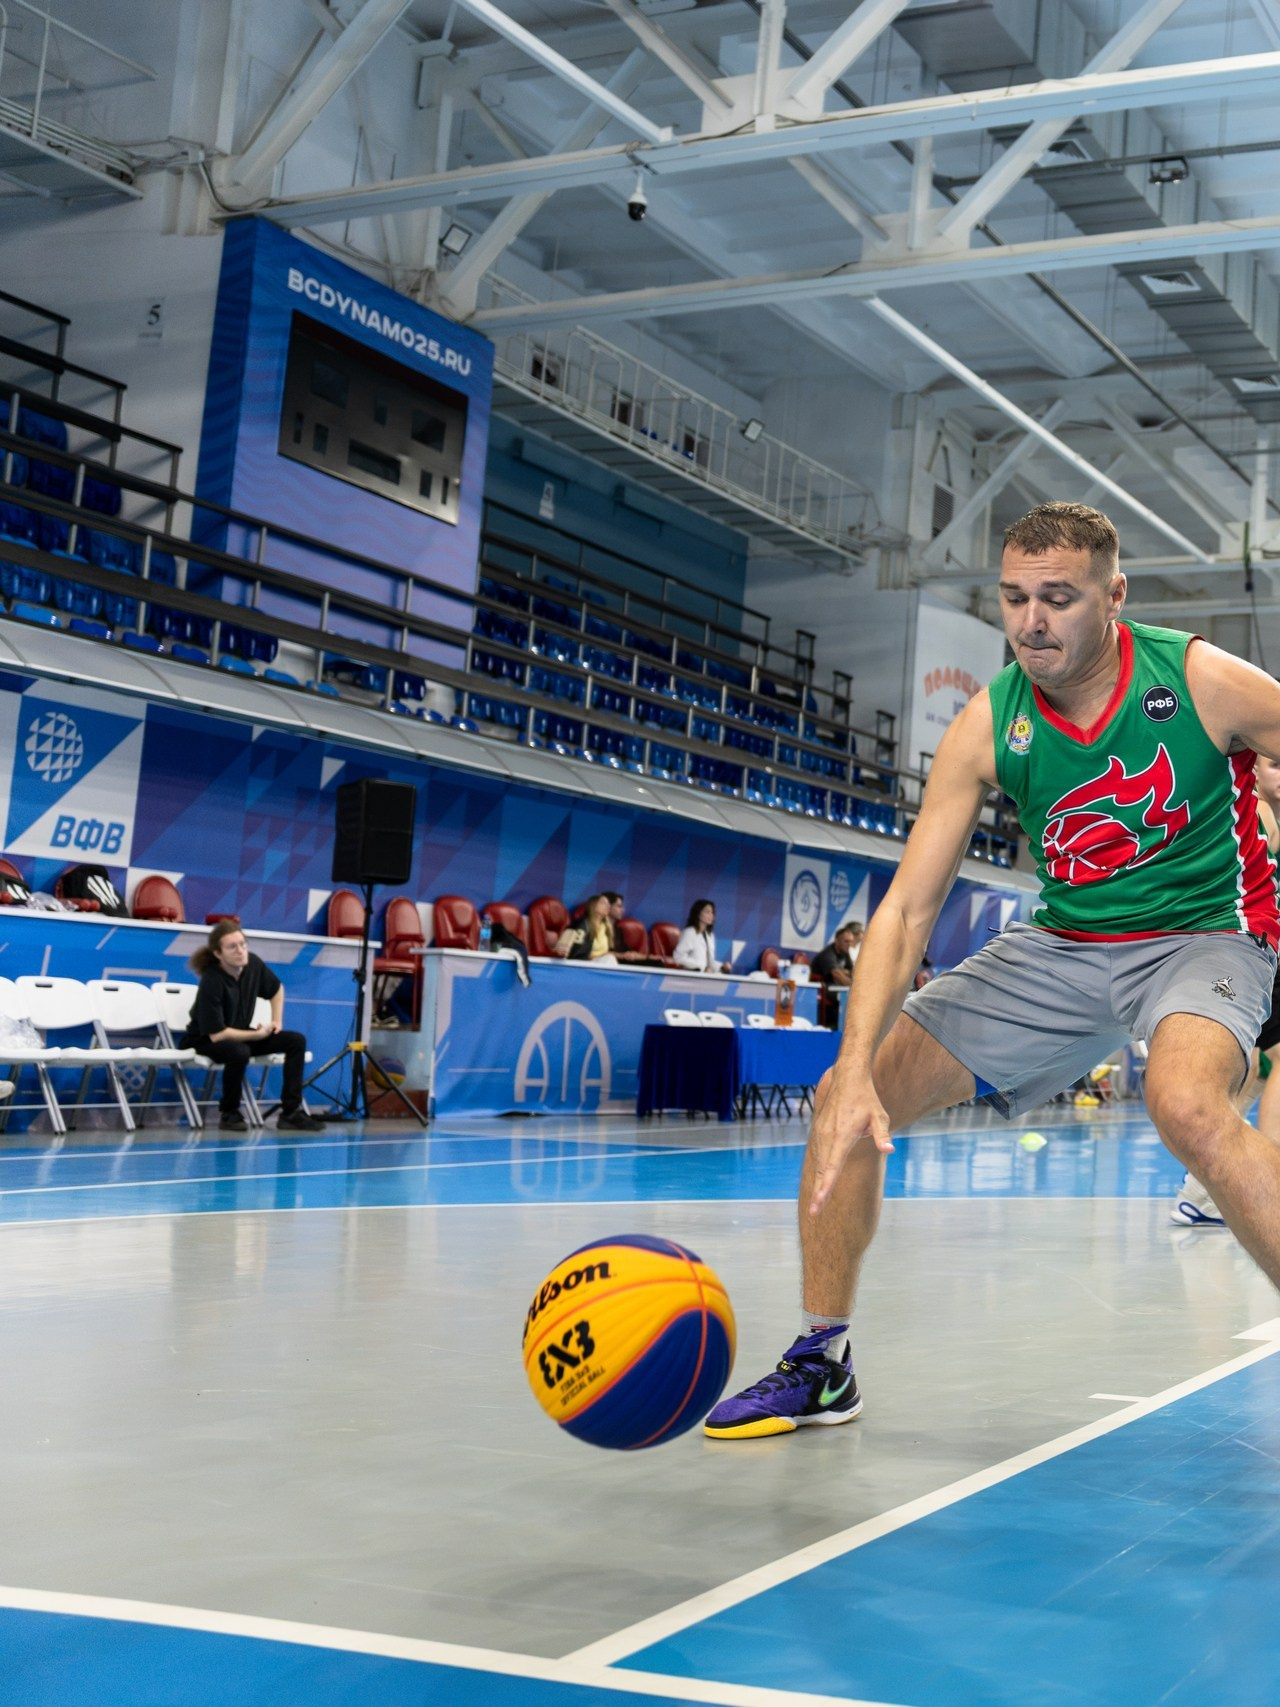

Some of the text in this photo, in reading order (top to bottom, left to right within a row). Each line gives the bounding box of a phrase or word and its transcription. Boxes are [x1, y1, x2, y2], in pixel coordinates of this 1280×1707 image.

[147, 303, 161, 326] 5
[287, 267, 471, 377] BCDYNAMO25.RU
[1147, 696, 1174, 711] РФБ
[49, 814, 126, 855] ВФВ
[588, 1365, 606, 1383] BALL
